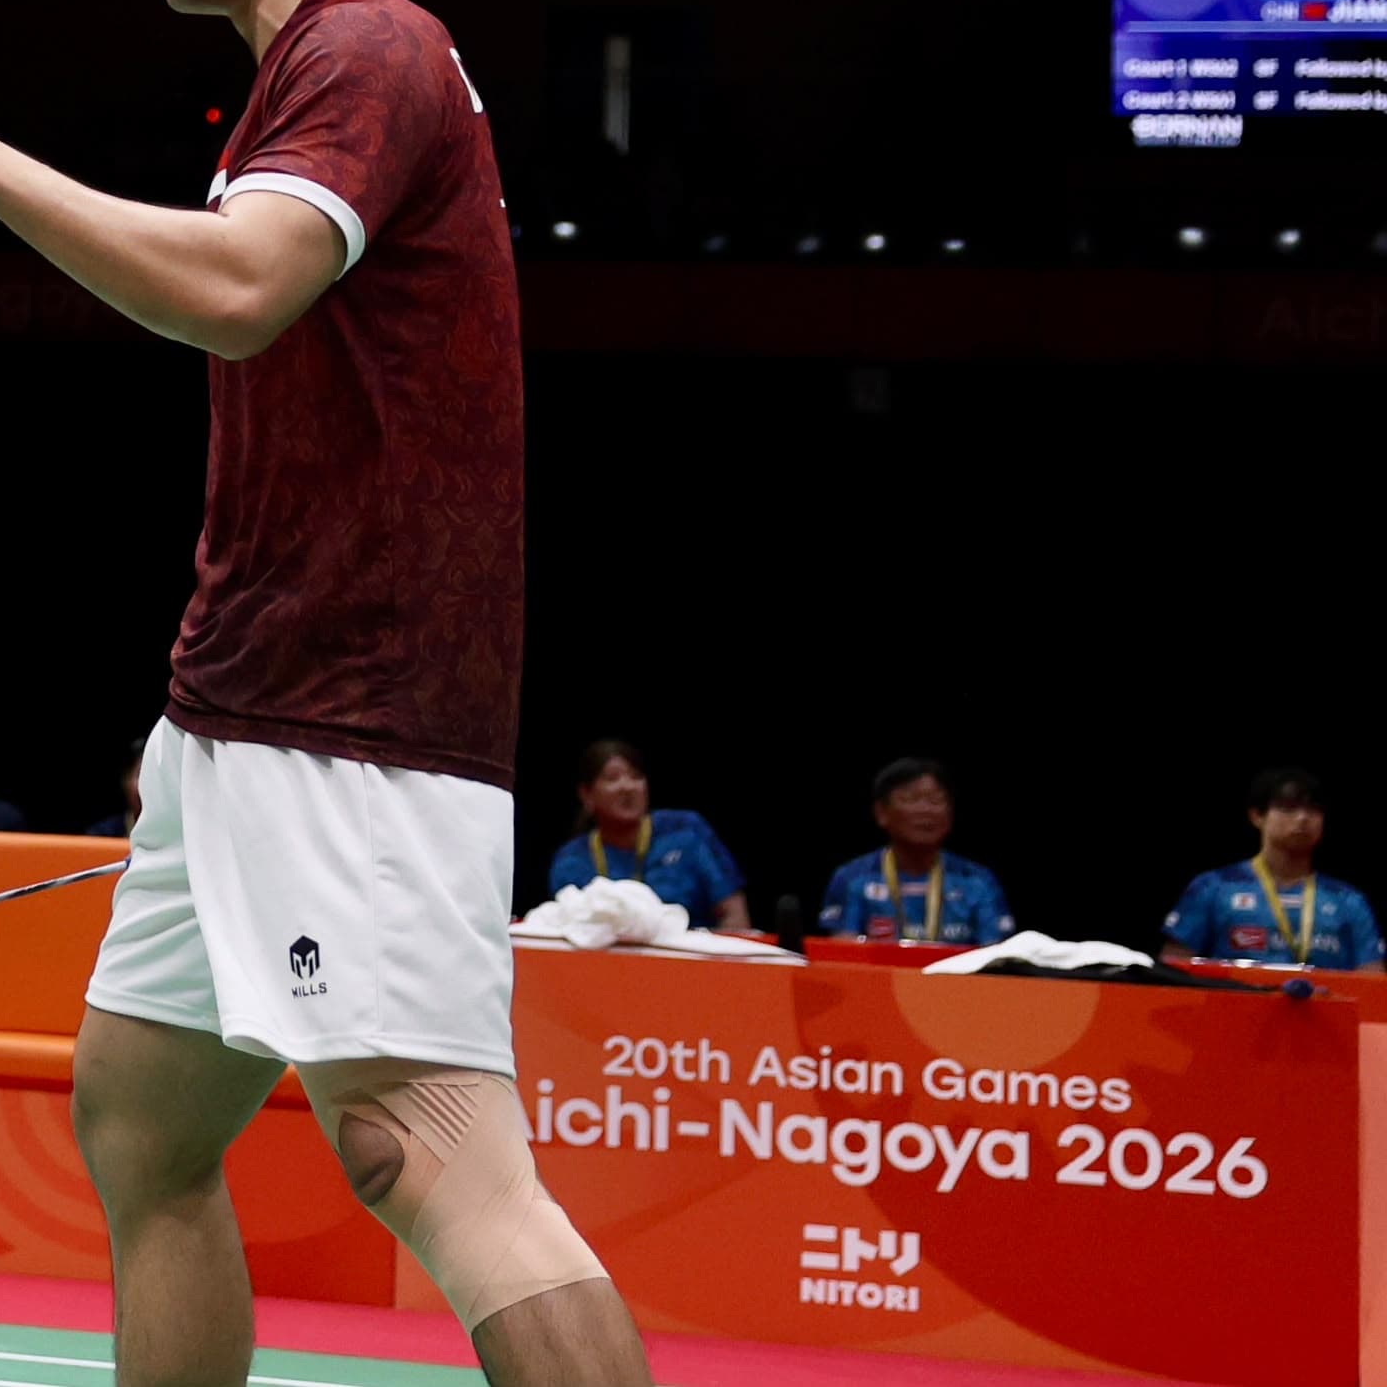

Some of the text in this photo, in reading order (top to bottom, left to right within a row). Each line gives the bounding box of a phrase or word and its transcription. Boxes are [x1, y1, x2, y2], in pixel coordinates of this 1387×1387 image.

[291, 982, 328, 999] MILLS
[603, 1036, 1132, 1112] 20th Asian Games
[1057, 1125, 1268, 1199] 2026
[800, 1224, 921, 1277] ニトリ
[800, 1277, 920, 1313] NITORI
